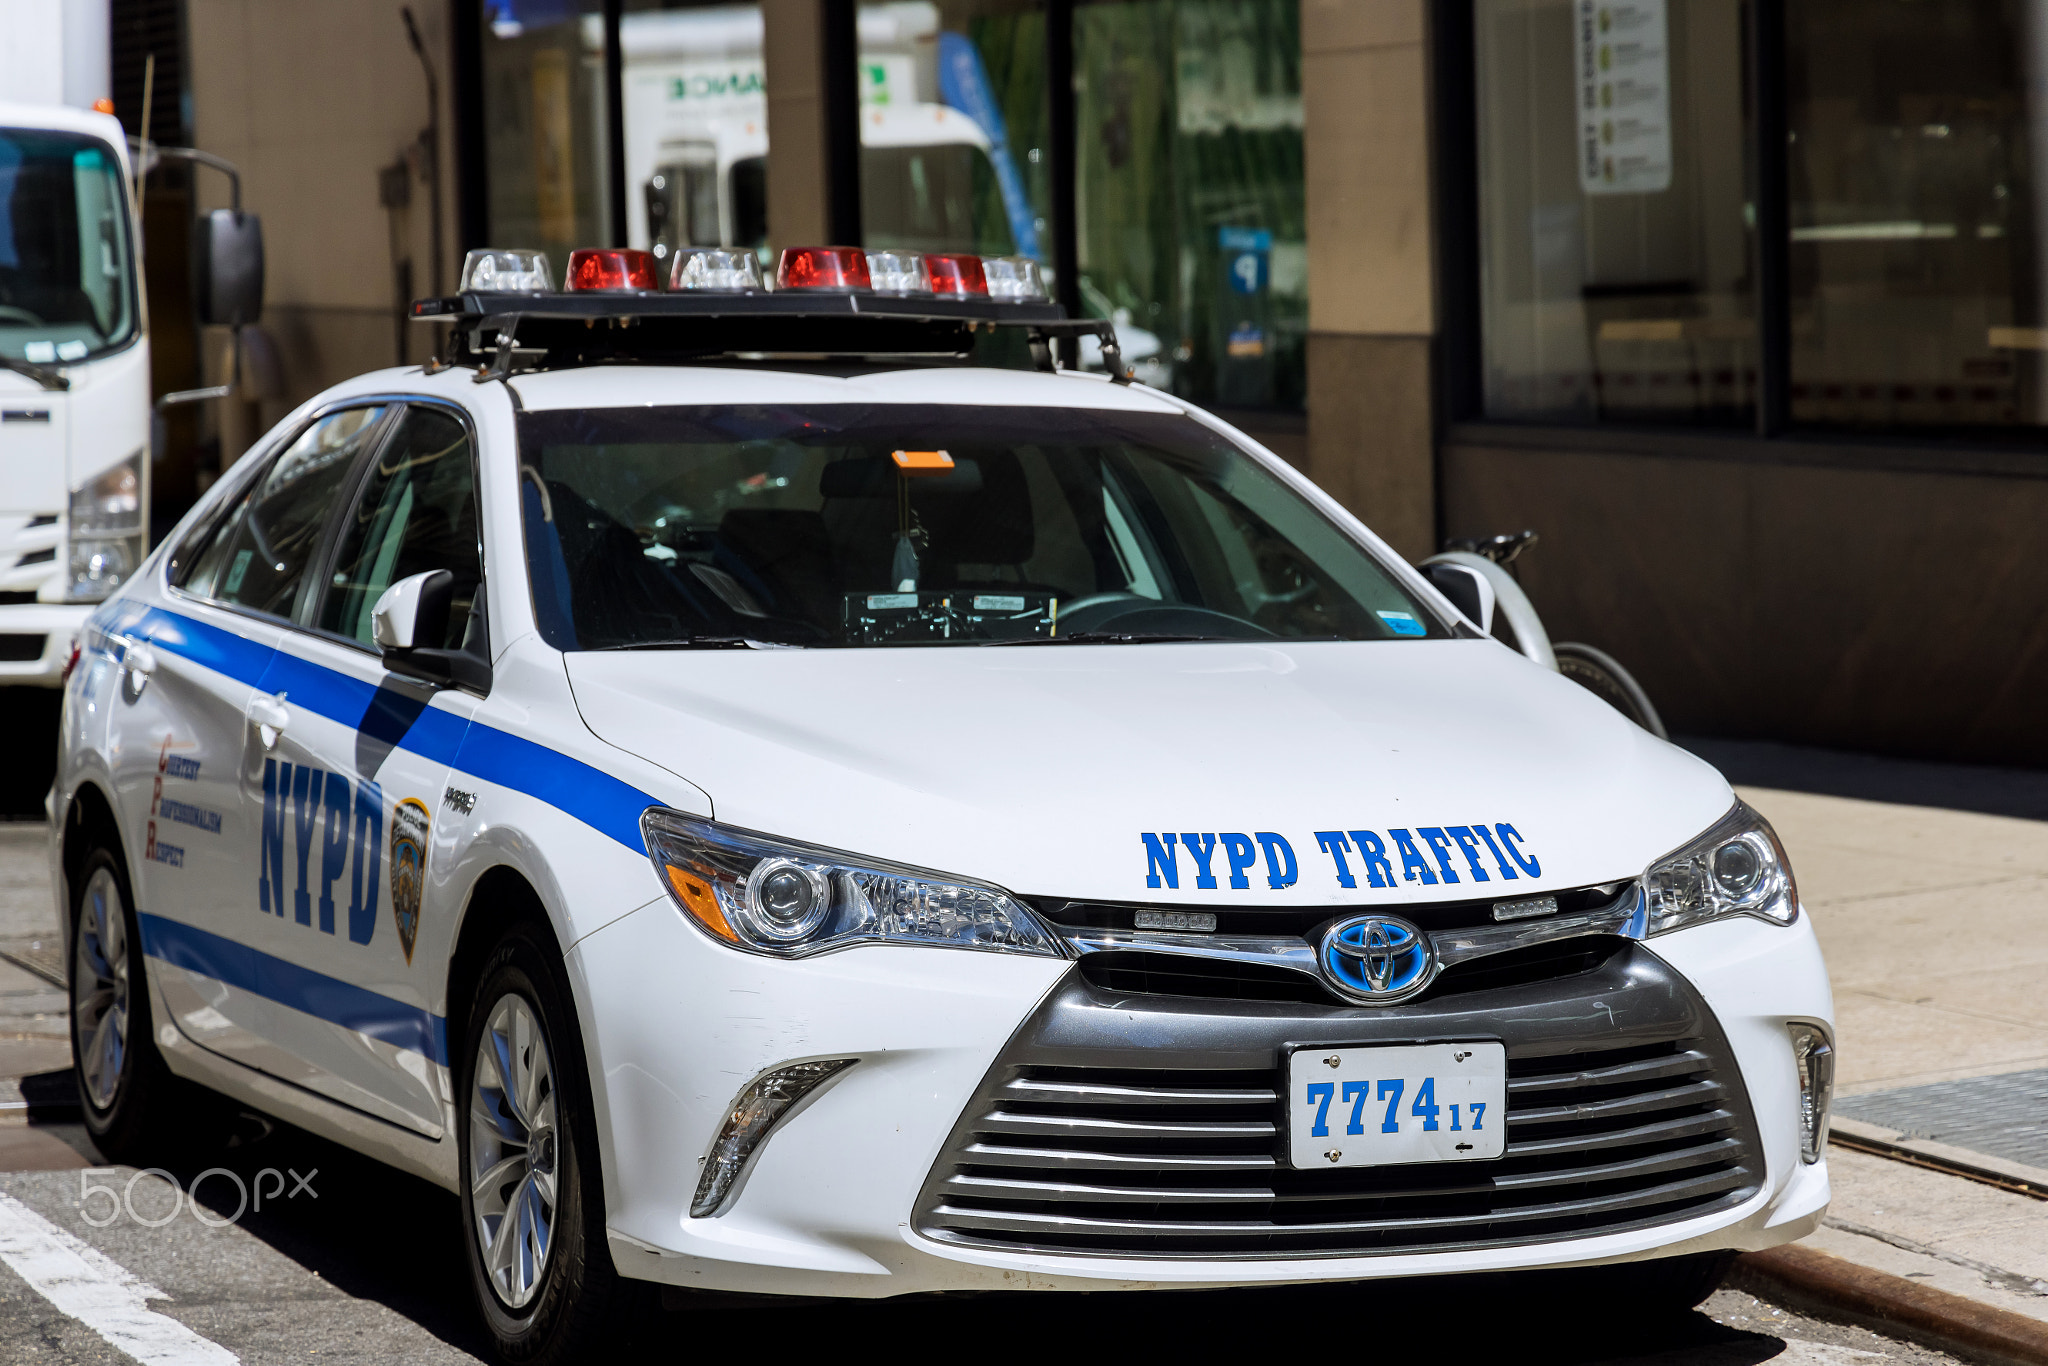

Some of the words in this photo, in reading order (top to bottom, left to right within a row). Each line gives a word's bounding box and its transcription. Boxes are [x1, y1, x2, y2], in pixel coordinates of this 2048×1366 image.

[259, 757, 383, 946] NYPD
[1141, 832, 1299, 890] NYPD
[1313, 822, 1542, 889] TRAFFIC
[1307, 1077, 1440, 1137] 7774
[1449, 1103, 1486, 1131] 17
